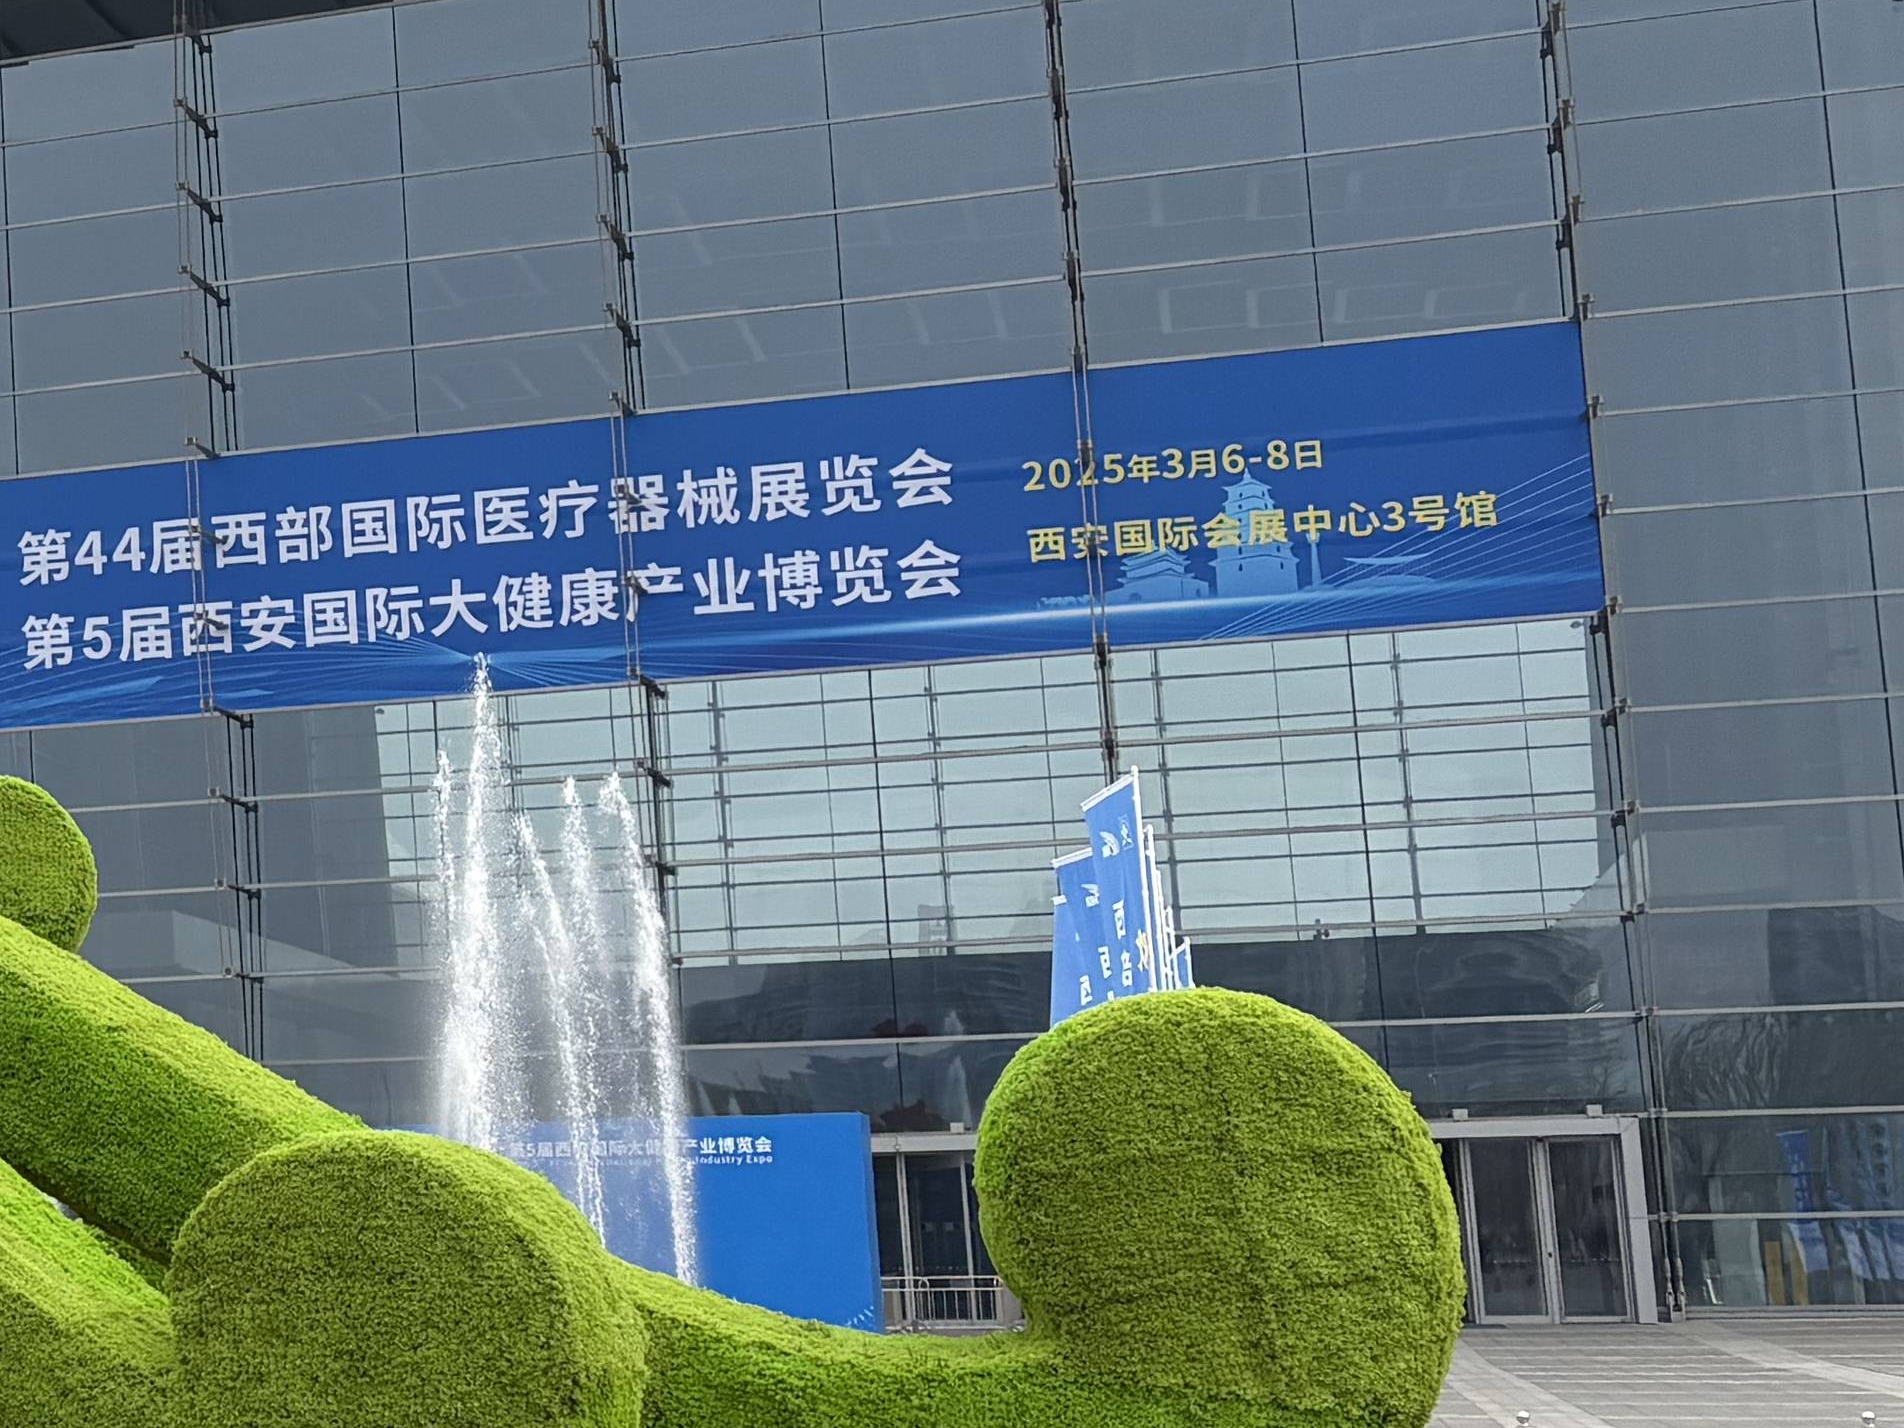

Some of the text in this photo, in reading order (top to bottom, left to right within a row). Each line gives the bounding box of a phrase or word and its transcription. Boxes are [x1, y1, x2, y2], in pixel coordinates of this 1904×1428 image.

[17, 447, 954, 586] 第44届西部国际医疗器械展览会
[1021, 439, 1324, 492] 2025年3月6-8日
[1027, 490, 1498, 563] 西安国际会展中心3号馆
[21, 539, 962, 670] 第5届西安国际大健康产业博览会
